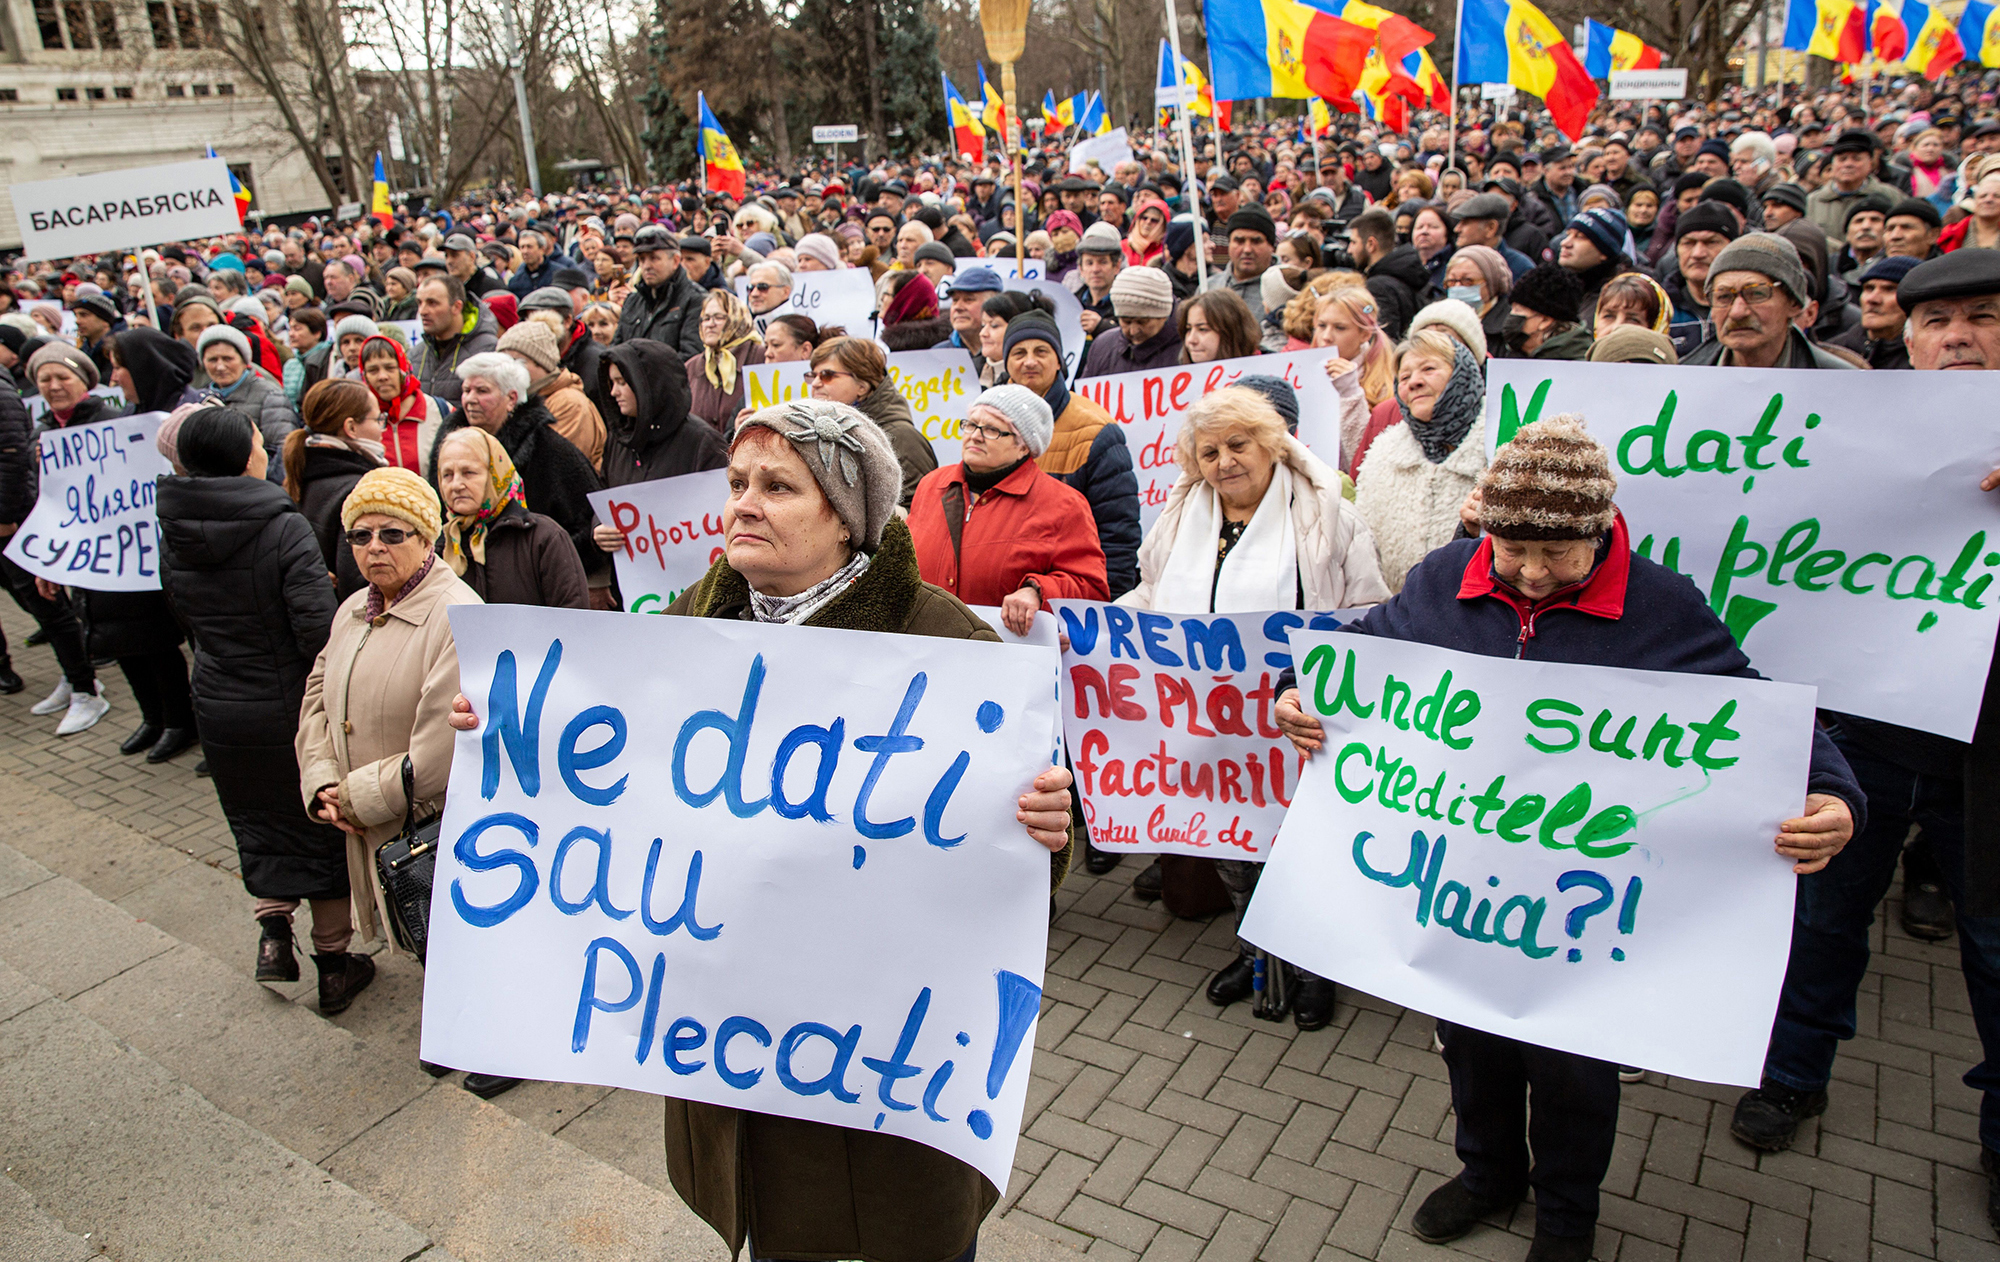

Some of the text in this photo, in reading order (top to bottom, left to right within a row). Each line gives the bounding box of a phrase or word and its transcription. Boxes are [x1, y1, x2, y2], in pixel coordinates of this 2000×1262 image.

[30, 187, 224, 233] БАСАРАБЯСКА
[1143, 372, 1192, 420] ne
[1617, 390, 1822, 494] dați
[60, 474, 157, 528] Являет
[21, 521, 161, 577] СУВЕРЕ
[608, 500, 725, 571] Poporu
[1710, 515, 2000, 633] plecați
[1060, 606, 1247, 672] VREM
[1302, 643, 1482, 751] Unde
[481, 638, 1004, 870] Ne dați
[1075, 729, 1300, 808] facturil
[1218, 815, 1258, 853] de
